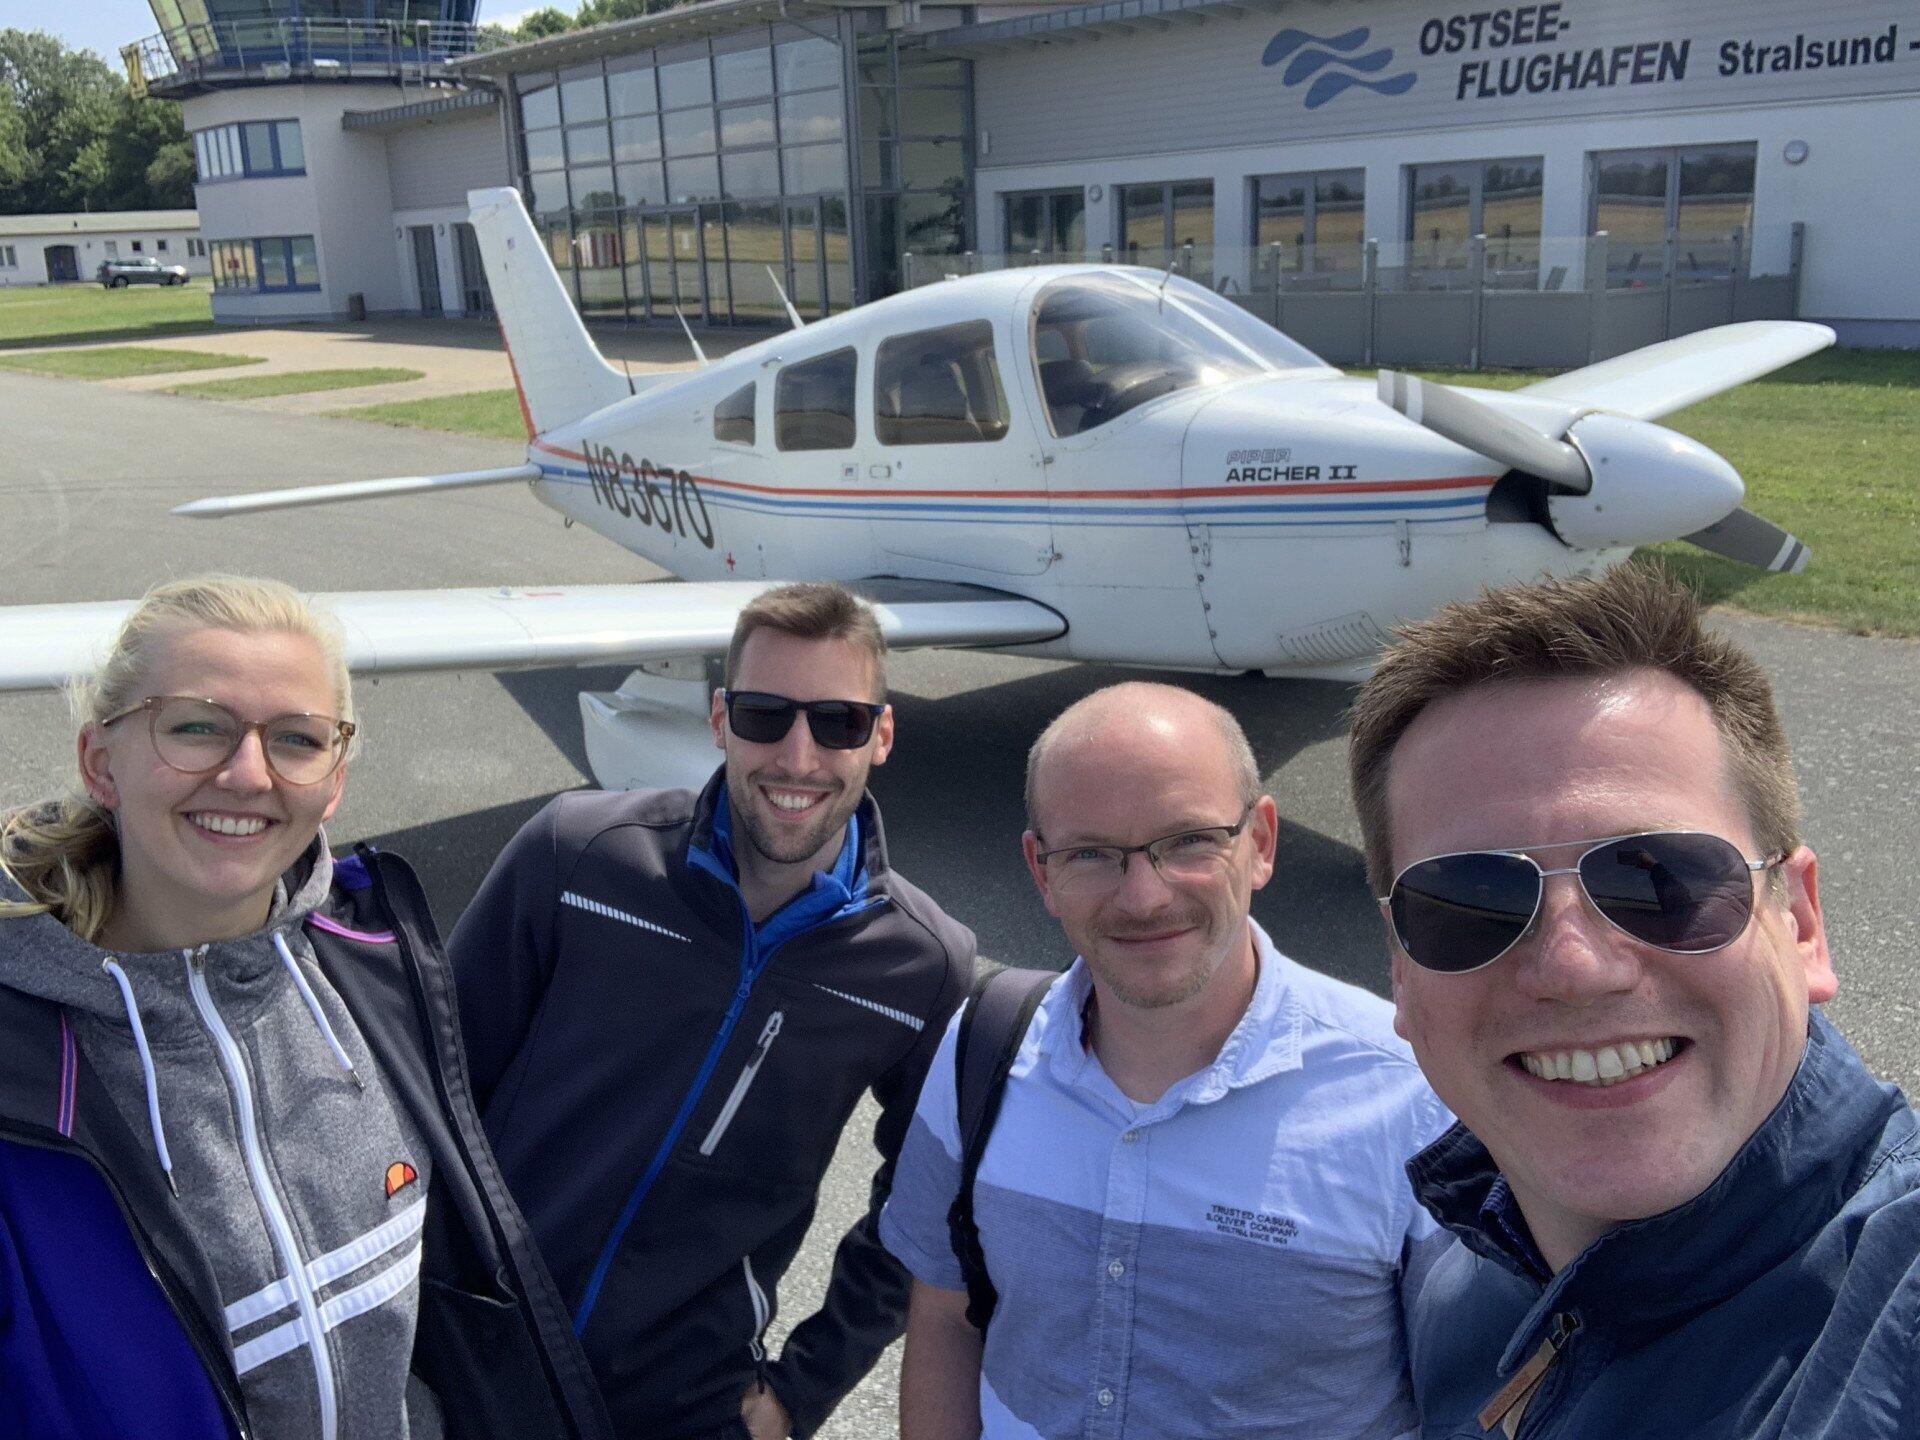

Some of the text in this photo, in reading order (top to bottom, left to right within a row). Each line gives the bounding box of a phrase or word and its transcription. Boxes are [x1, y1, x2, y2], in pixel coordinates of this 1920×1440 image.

[1419, 3, 1571, 56] OSTSEE-
[1456, 39, 1691, 100] FLUGHAFEN
[1717, 24, 1898, 77] Stralsund
[1226, 448, 1292, 465] PIPER
[1226, 465, 1358, 482] ARCHER II
[582, 438, 715, 550] N83670
[1212, 1205, 1296, 1230] TRUSTED CASUAL
[1250, 1222, 1299, 1237] COMPANY
